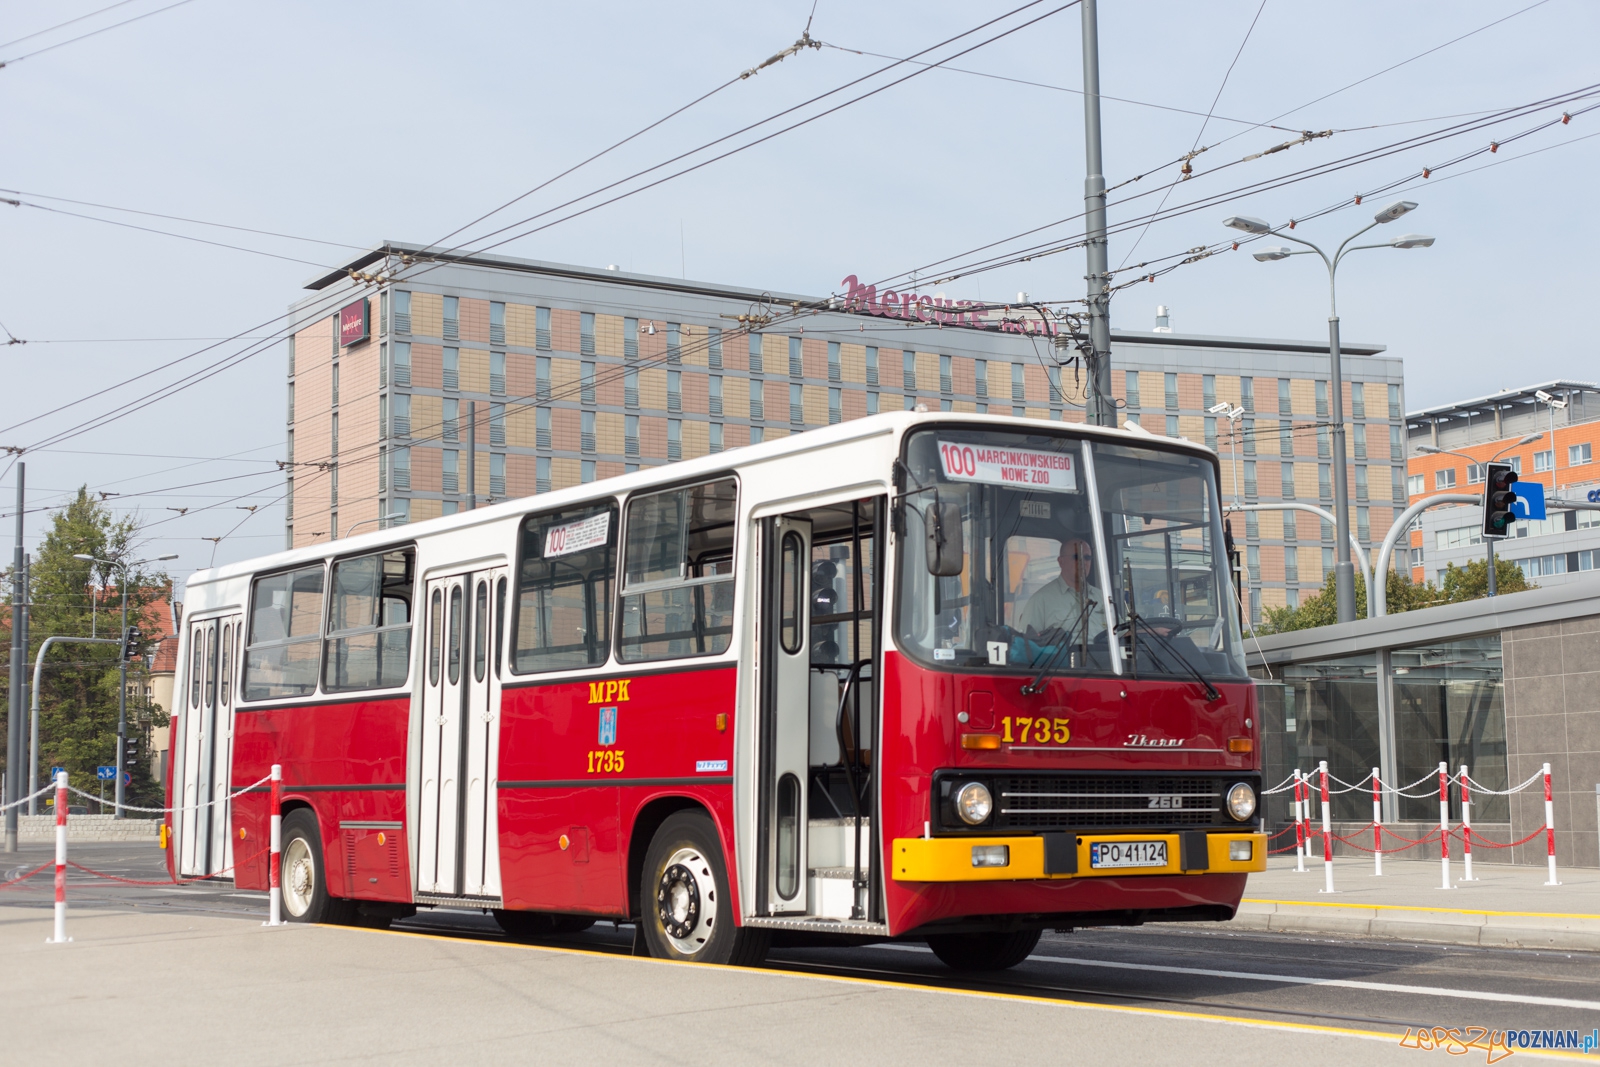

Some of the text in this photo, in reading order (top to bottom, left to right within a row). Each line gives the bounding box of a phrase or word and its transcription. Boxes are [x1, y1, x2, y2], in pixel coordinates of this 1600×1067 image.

[841, 274, 988, 329] Mercure
[342, 318, 362, 332] Mercure
[941, 443, 1070, 476] 100 MARCINKOWSKIEGO
[1001, 466, 1049, 484] NOWE ZOO
[549, 526, 567, 553] 100
[993, 645, 1000, 662] 1
[588, 679, 631, 704] MPK
[1001, 716, 1070, 744] 1735
[587, 750, 625, 773] 1735
[1148, 796, 1183, 809] 260
[1100, 843, 1165, 862] PO 41124
